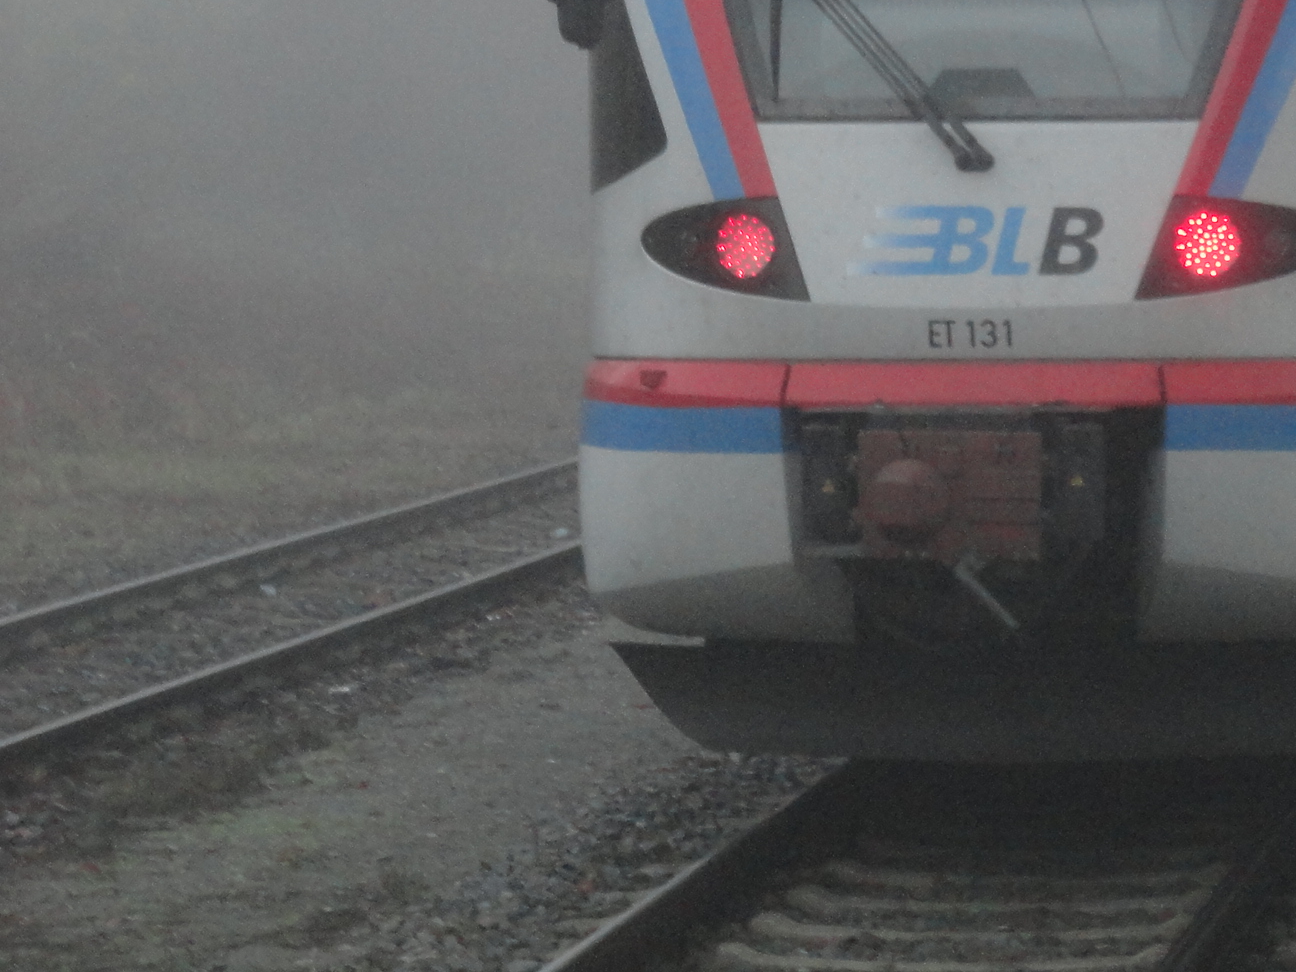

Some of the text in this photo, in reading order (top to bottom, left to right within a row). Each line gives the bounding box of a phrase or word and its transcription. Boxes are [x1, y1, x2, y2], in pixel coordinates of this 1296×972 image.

[868, 205, 1104, 276] BLB
[927, 320, 1013, 348] ET 131
